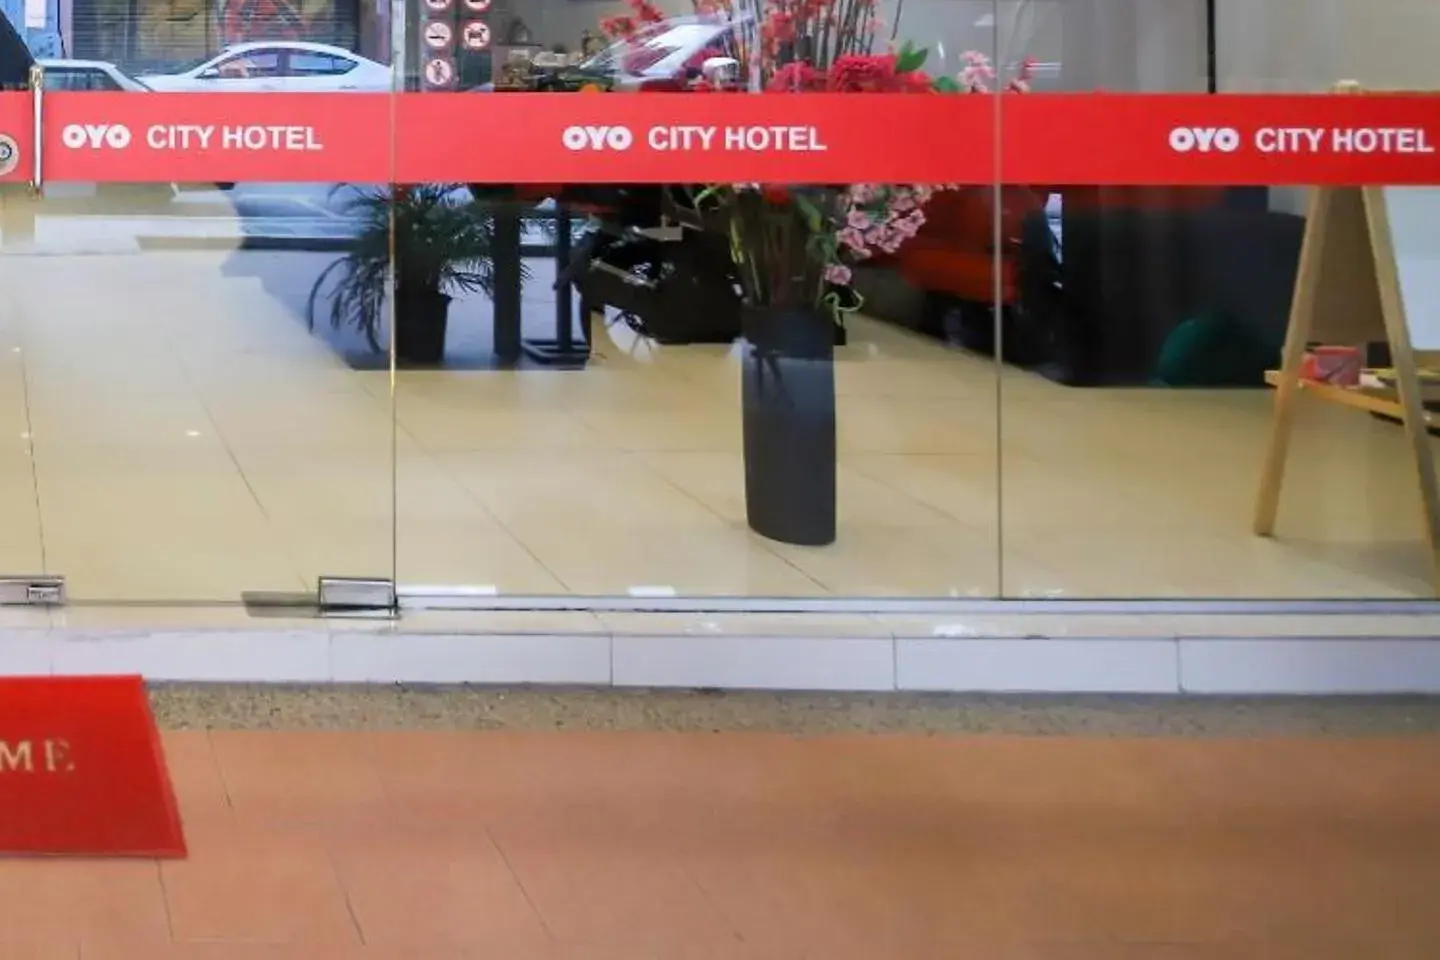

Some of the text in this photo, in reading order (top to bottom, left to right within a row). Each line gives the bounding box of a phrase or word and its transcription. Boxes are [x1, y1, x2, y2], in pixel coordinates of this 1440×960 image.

[61, 123, 323, 150] OYO CITY HOTEL
[561, 125, 827, 151] OYO CITY HOTEL
[1169, 126, 1433, 153] OYO CITY HOTEL
